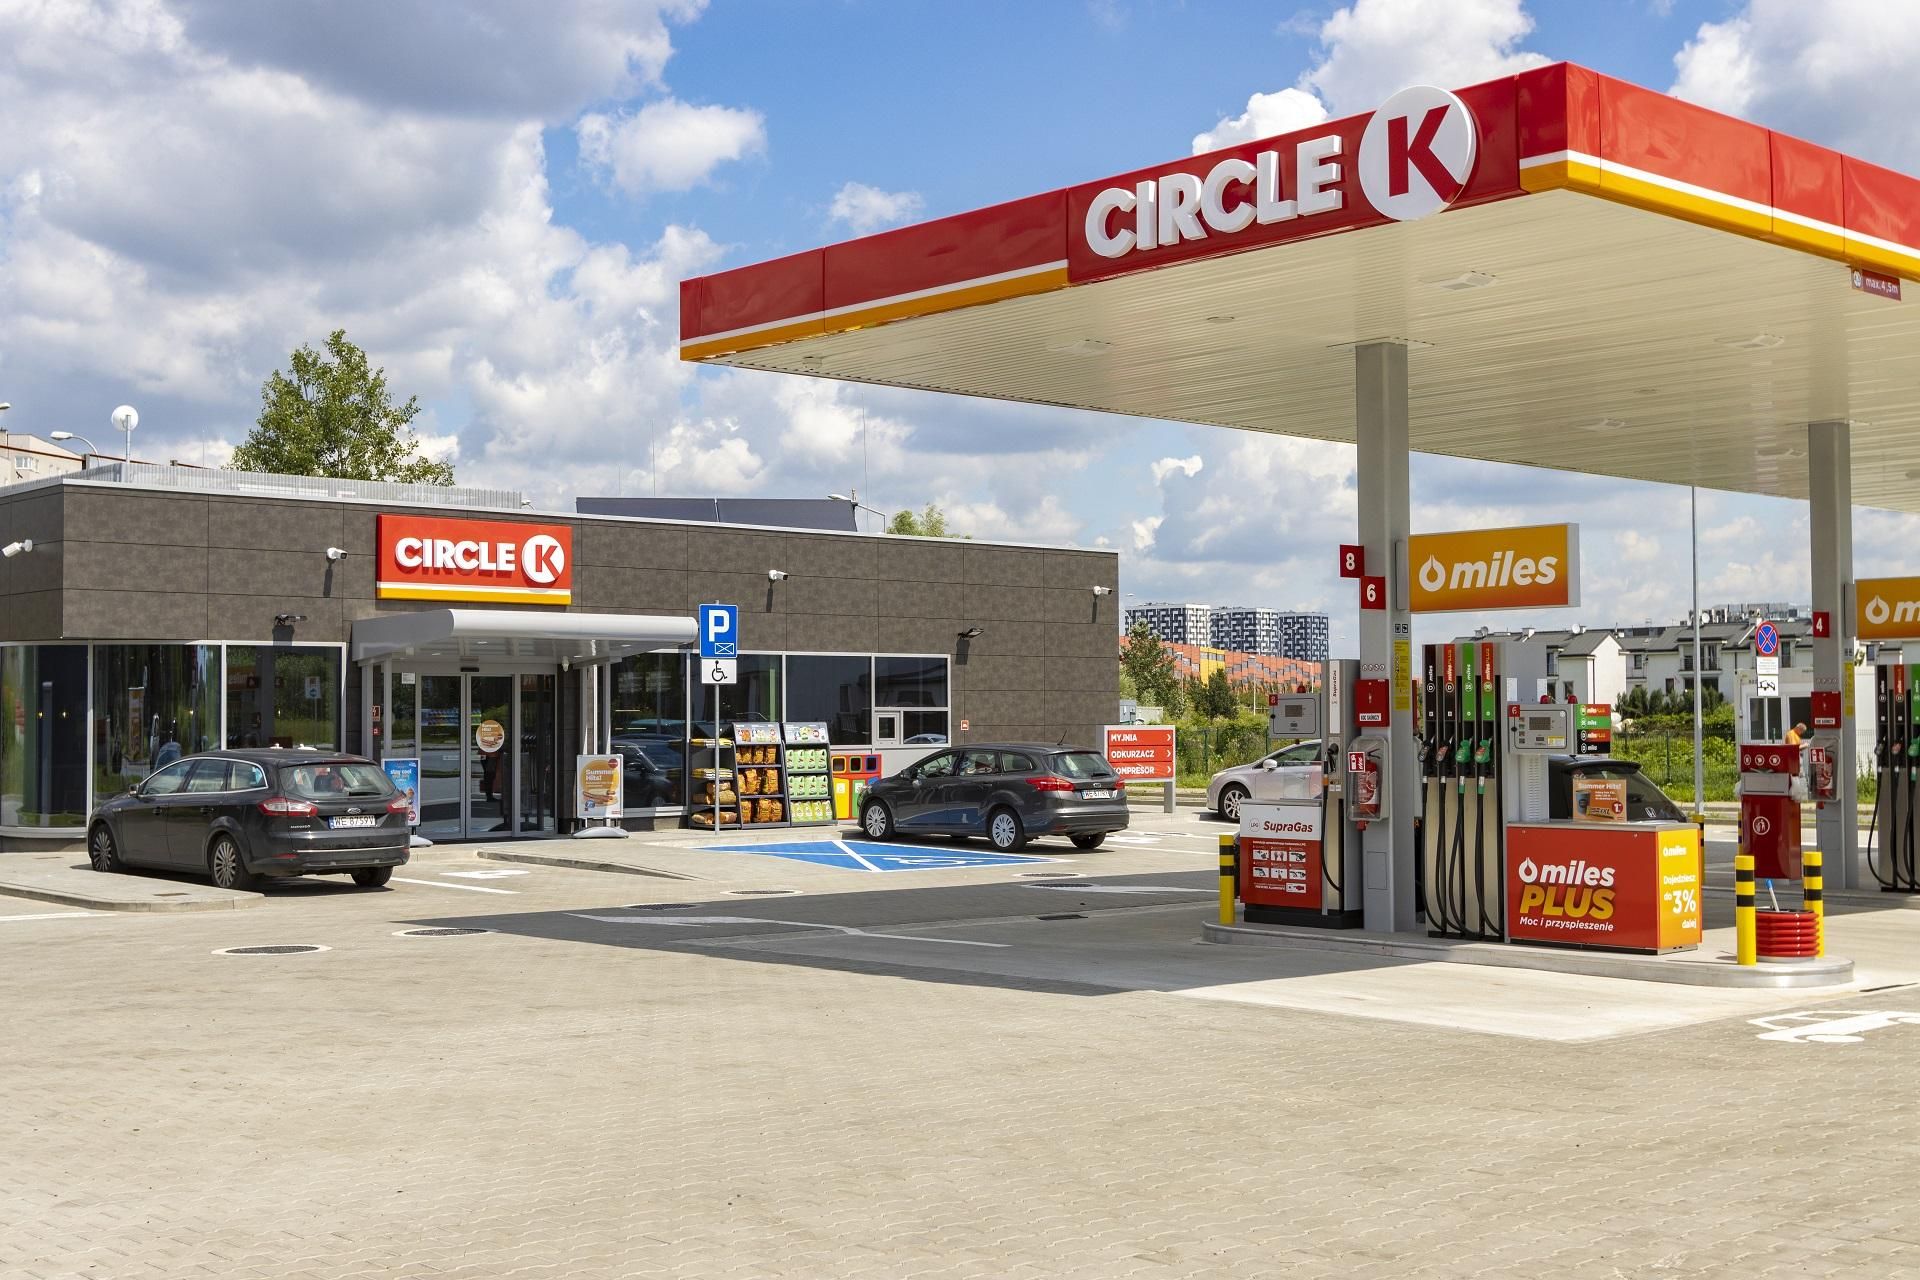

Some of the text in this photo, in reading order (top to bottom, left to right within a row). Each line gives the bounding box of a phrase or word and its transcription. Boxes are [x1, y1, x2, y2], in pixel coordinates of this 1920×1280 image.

[1085, 103, 1465, 258] CIRCLE K
[395, 537, 563, 580] CIRCLE K
[1346, 552, 1355, 571] 8
[1450, 551, 1559, 589] miles
[1366, 583, 1376, 602] 6
[708, 609, 730, 642] P
[1816, 617, 1823, 632] 4
[1111, 734, 1137, 742] MYJNIA
[1111, 750, 1154, 758] ODKURZACZ
[335, 817, 346, 826] WE
[1263, 821, 1313, 833] SupraGas
[1668, 845, 1686, 856] miles
[1540, 860, 1615, 887] miles
[1663, 874, 1696, 885] Dojedziesz
[1519, 885, 1616, 920] PLUS
[1663, 889, 1696, 914] do 3%
[1520, 916, 1614, 932] Moc i przyspieszenie
[1682, 919, 1696, 929] dalej
